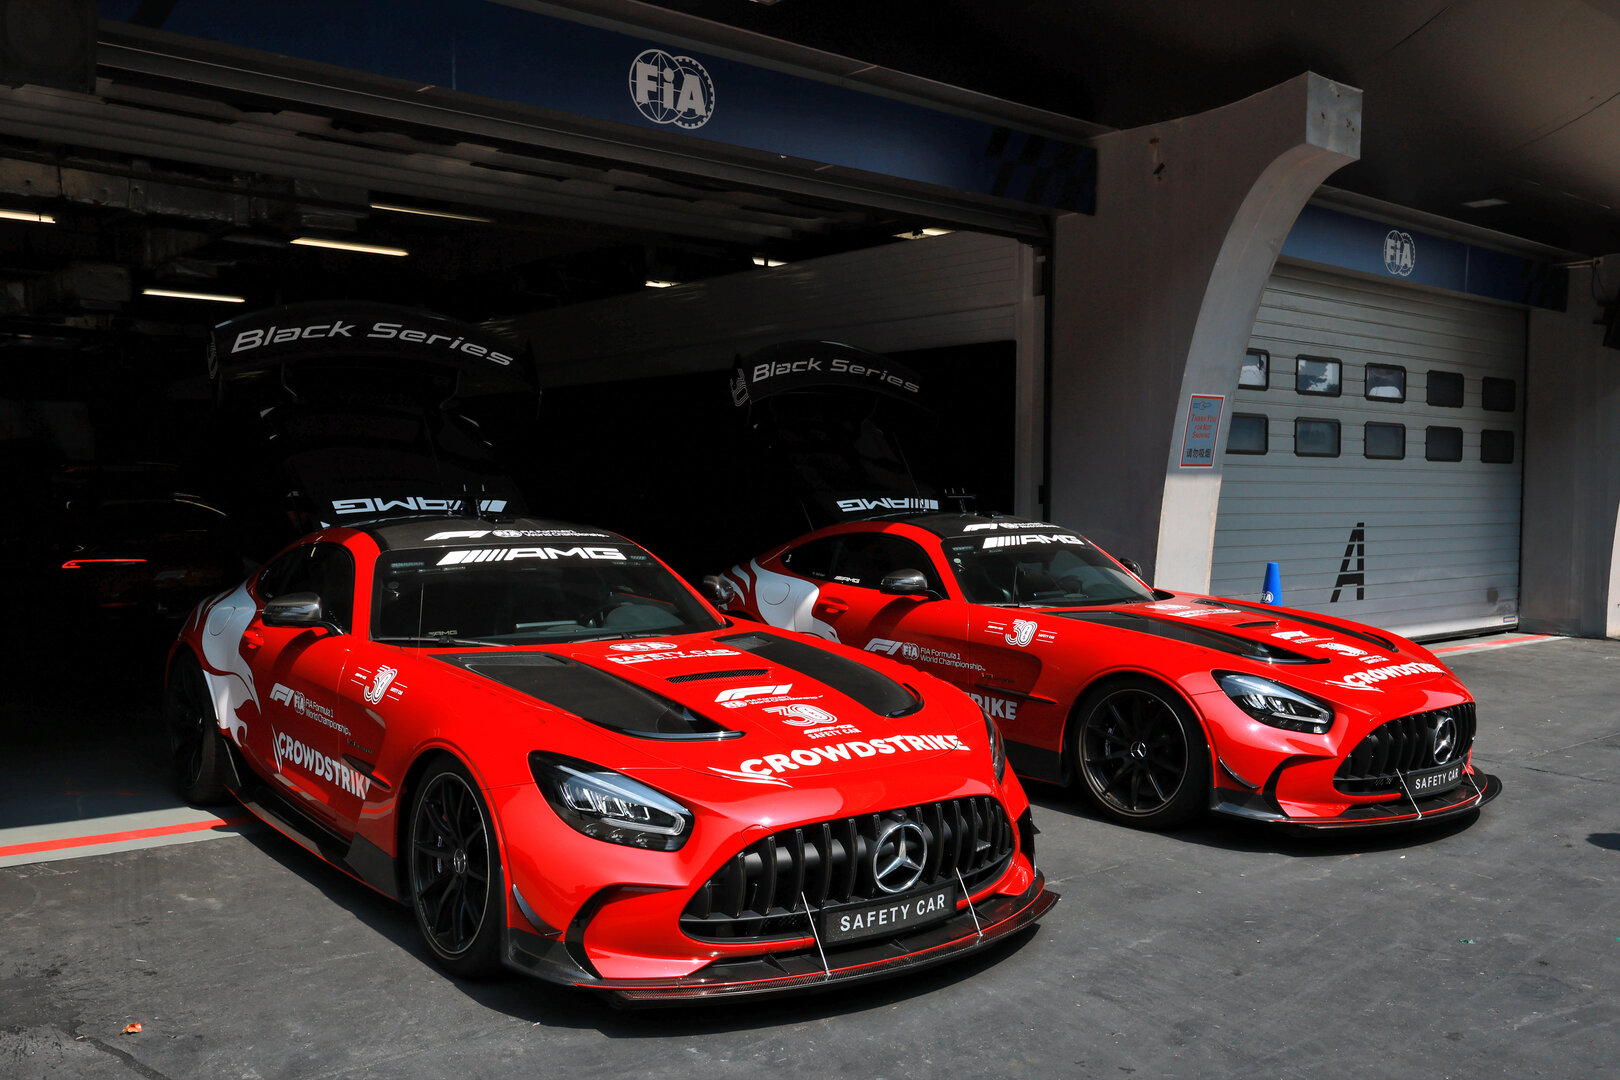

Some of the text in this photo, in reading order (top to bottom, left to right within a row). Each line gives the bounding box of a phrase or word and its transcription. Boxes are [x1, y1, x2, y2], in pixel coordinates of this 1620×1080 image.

[231, 320, 514, 367] Black Series
[752, 357, 920, 393] Black Series
[1330, 522, 1364, 603] A
[863, 637, 903, 655] F1
[920, 654, 938, 663] World
[931, 648, 957, 659] Formula
[269, 682, 295, 707] F1
[807, 730, 841, 739] SAFETY
[278, 732, 371, 800] CROWDSTRIK
[740, 734, 971, 776] CROWDSTRIKE
[1415, 768, 1459, 790] SAFETY CAR
[840, 893, 945, 932] SAFETY CAR
